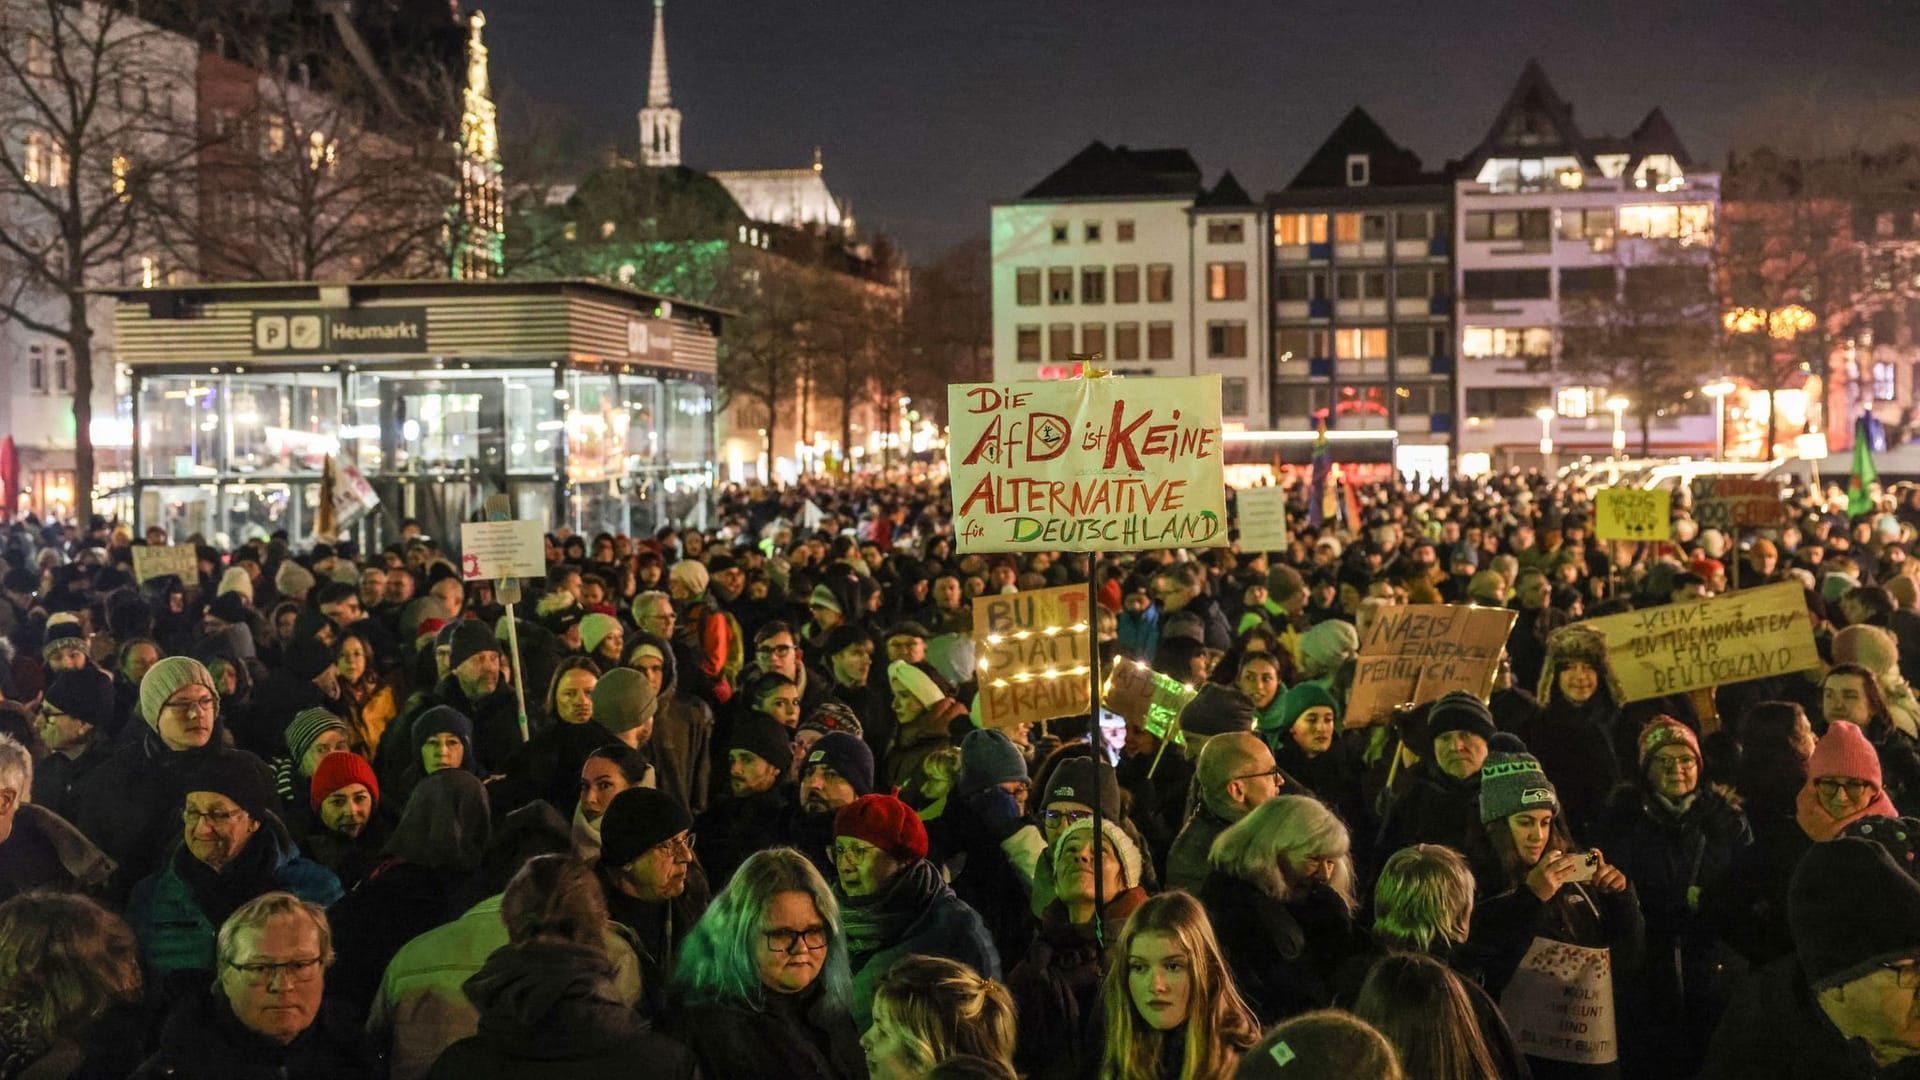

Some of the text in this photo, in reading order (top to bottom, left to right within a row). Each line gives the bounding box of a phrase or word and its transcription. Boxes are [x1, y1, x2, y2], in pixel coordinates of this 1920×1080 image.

[332, 322, 418, 340] Heumarkt
[961, 412, 1072, 469] AfD
[1081, 421, 1107, 451] ist
[1003, 510, 1219, 546] DEUTSCHLAND
[986, 591, 1087, 633] BUNT
[1371, 612, 1452, 646] NAZIS
[989, 634, 1079, 670] STATT
[1653, 646, 1792, 693] DEUTSCHLAND
[989, 676, 1090, 721] BRAUN
[1560, 1019, 1588, 1034] UND
